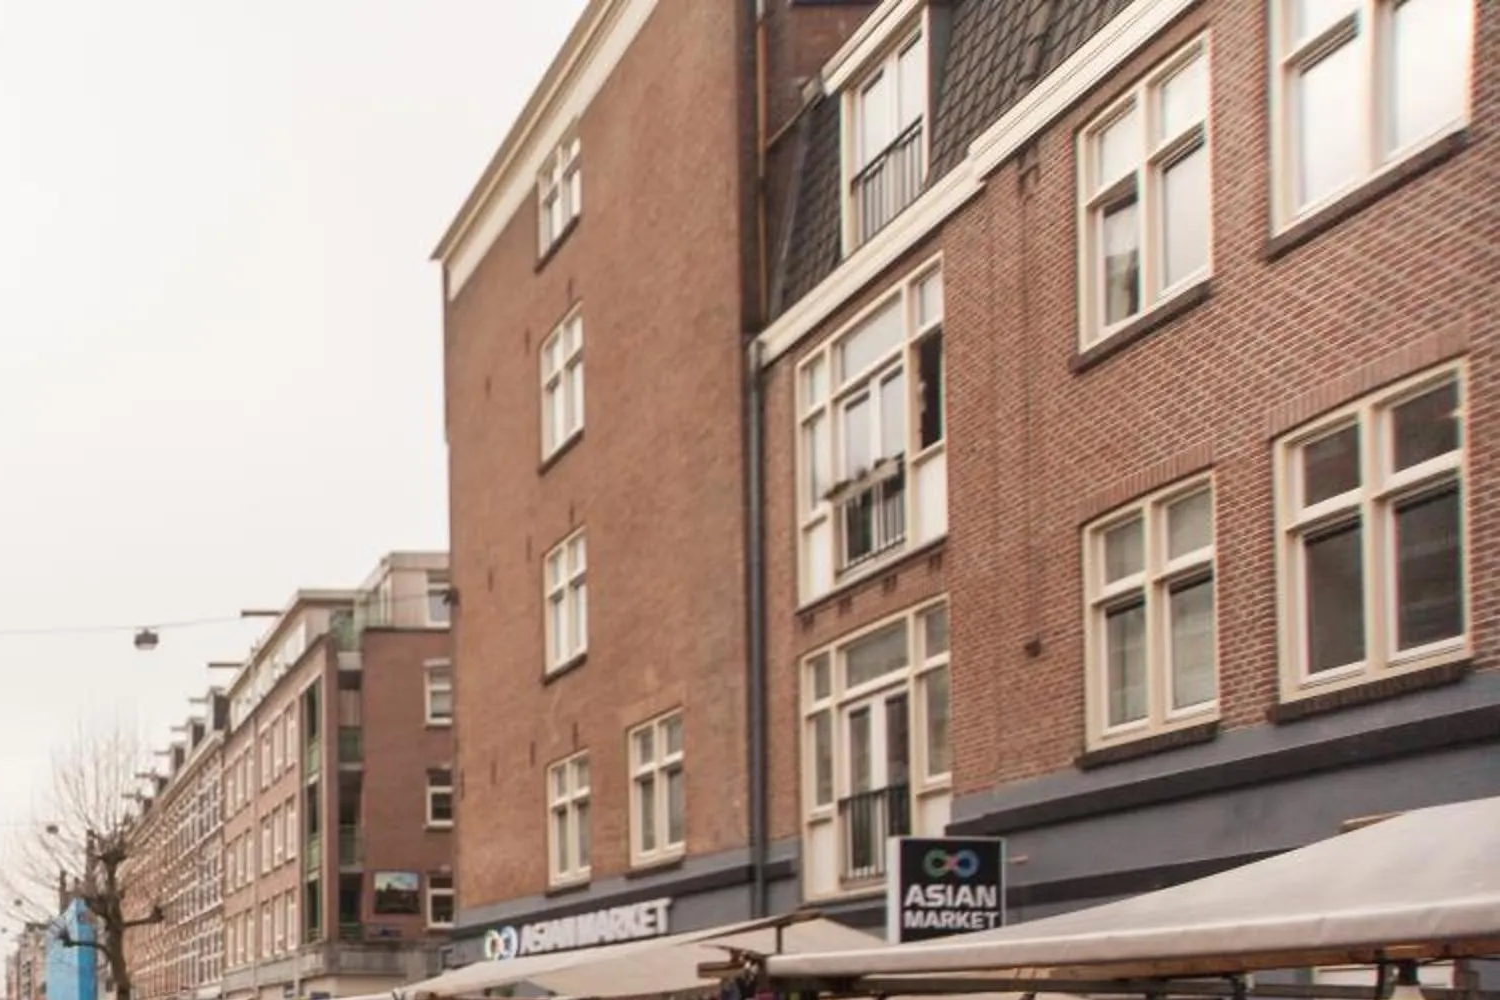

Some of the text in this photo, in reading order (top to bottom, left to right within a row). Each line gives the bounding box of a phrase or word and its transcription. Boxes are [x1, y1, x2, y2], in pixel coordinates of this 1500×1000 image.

[903, 883, 998, 908] ASIAN
[578, 897, 672, 949] MARKET
[903, 909, 1000, 930] MARKET
